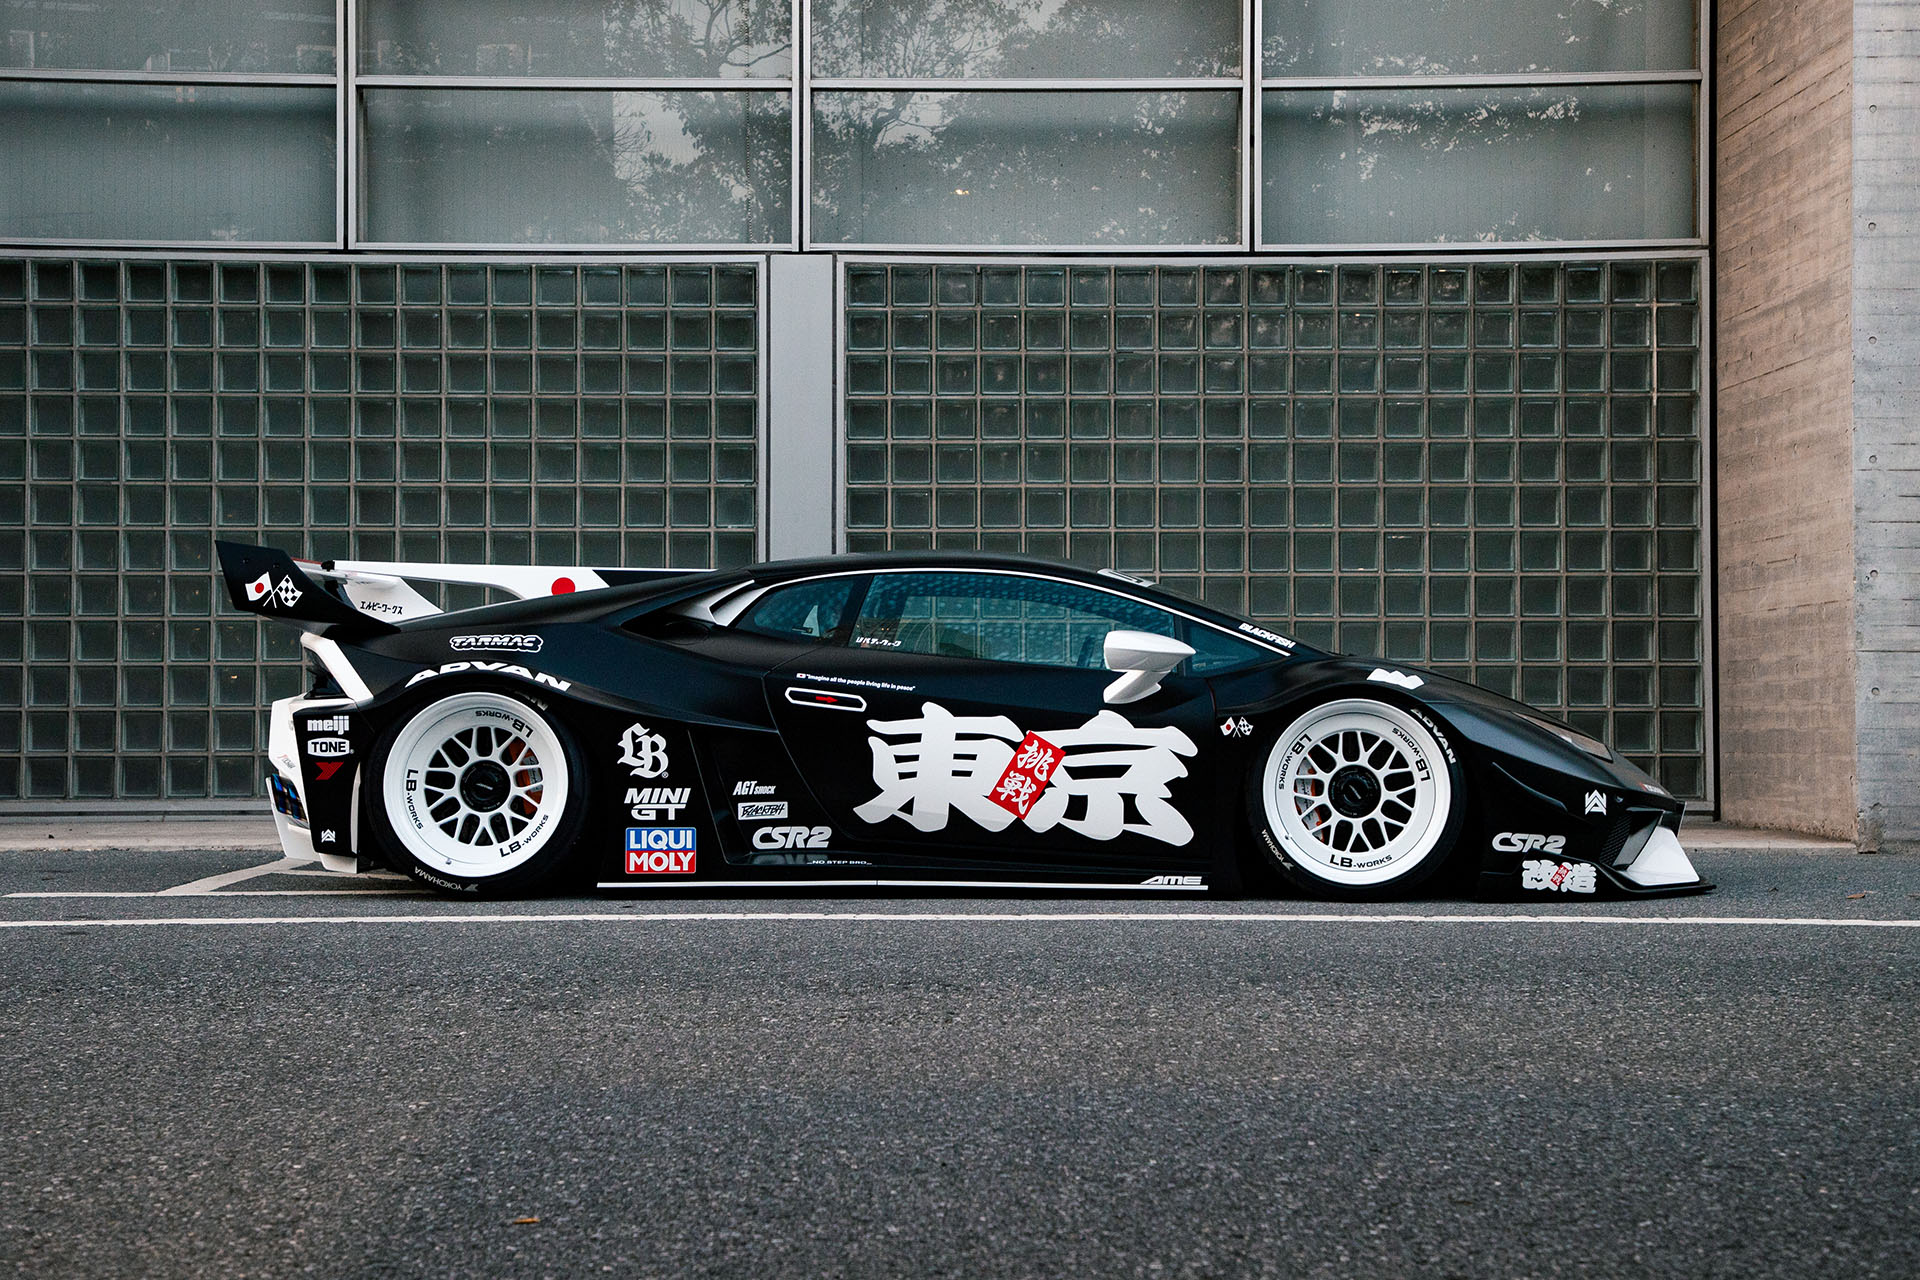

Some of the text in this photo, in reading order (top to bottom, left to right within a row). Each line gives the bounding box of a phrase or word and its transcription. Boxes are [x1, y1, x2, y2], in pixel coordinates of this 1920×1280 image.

[404, 661, 572, 692] ADVAN
[307, 715, 350, 736] meiji
[1410, 708, 1457, 764] ADVAN
[311, 741, 347, 753] TONE
[624, 787, 691, 804] MINI
[631, 803, 686, 821] GT
[629, 830, 693, 850] LIQUI
[752, 826, 832, 849] CSR2
[1491, 832, 1567, 854] CSR2
[629, 852, 695, 871] MOLY
[414, 865, 463, 891] YOKOHAMA
[1140, 875, 1203, 885] AME
